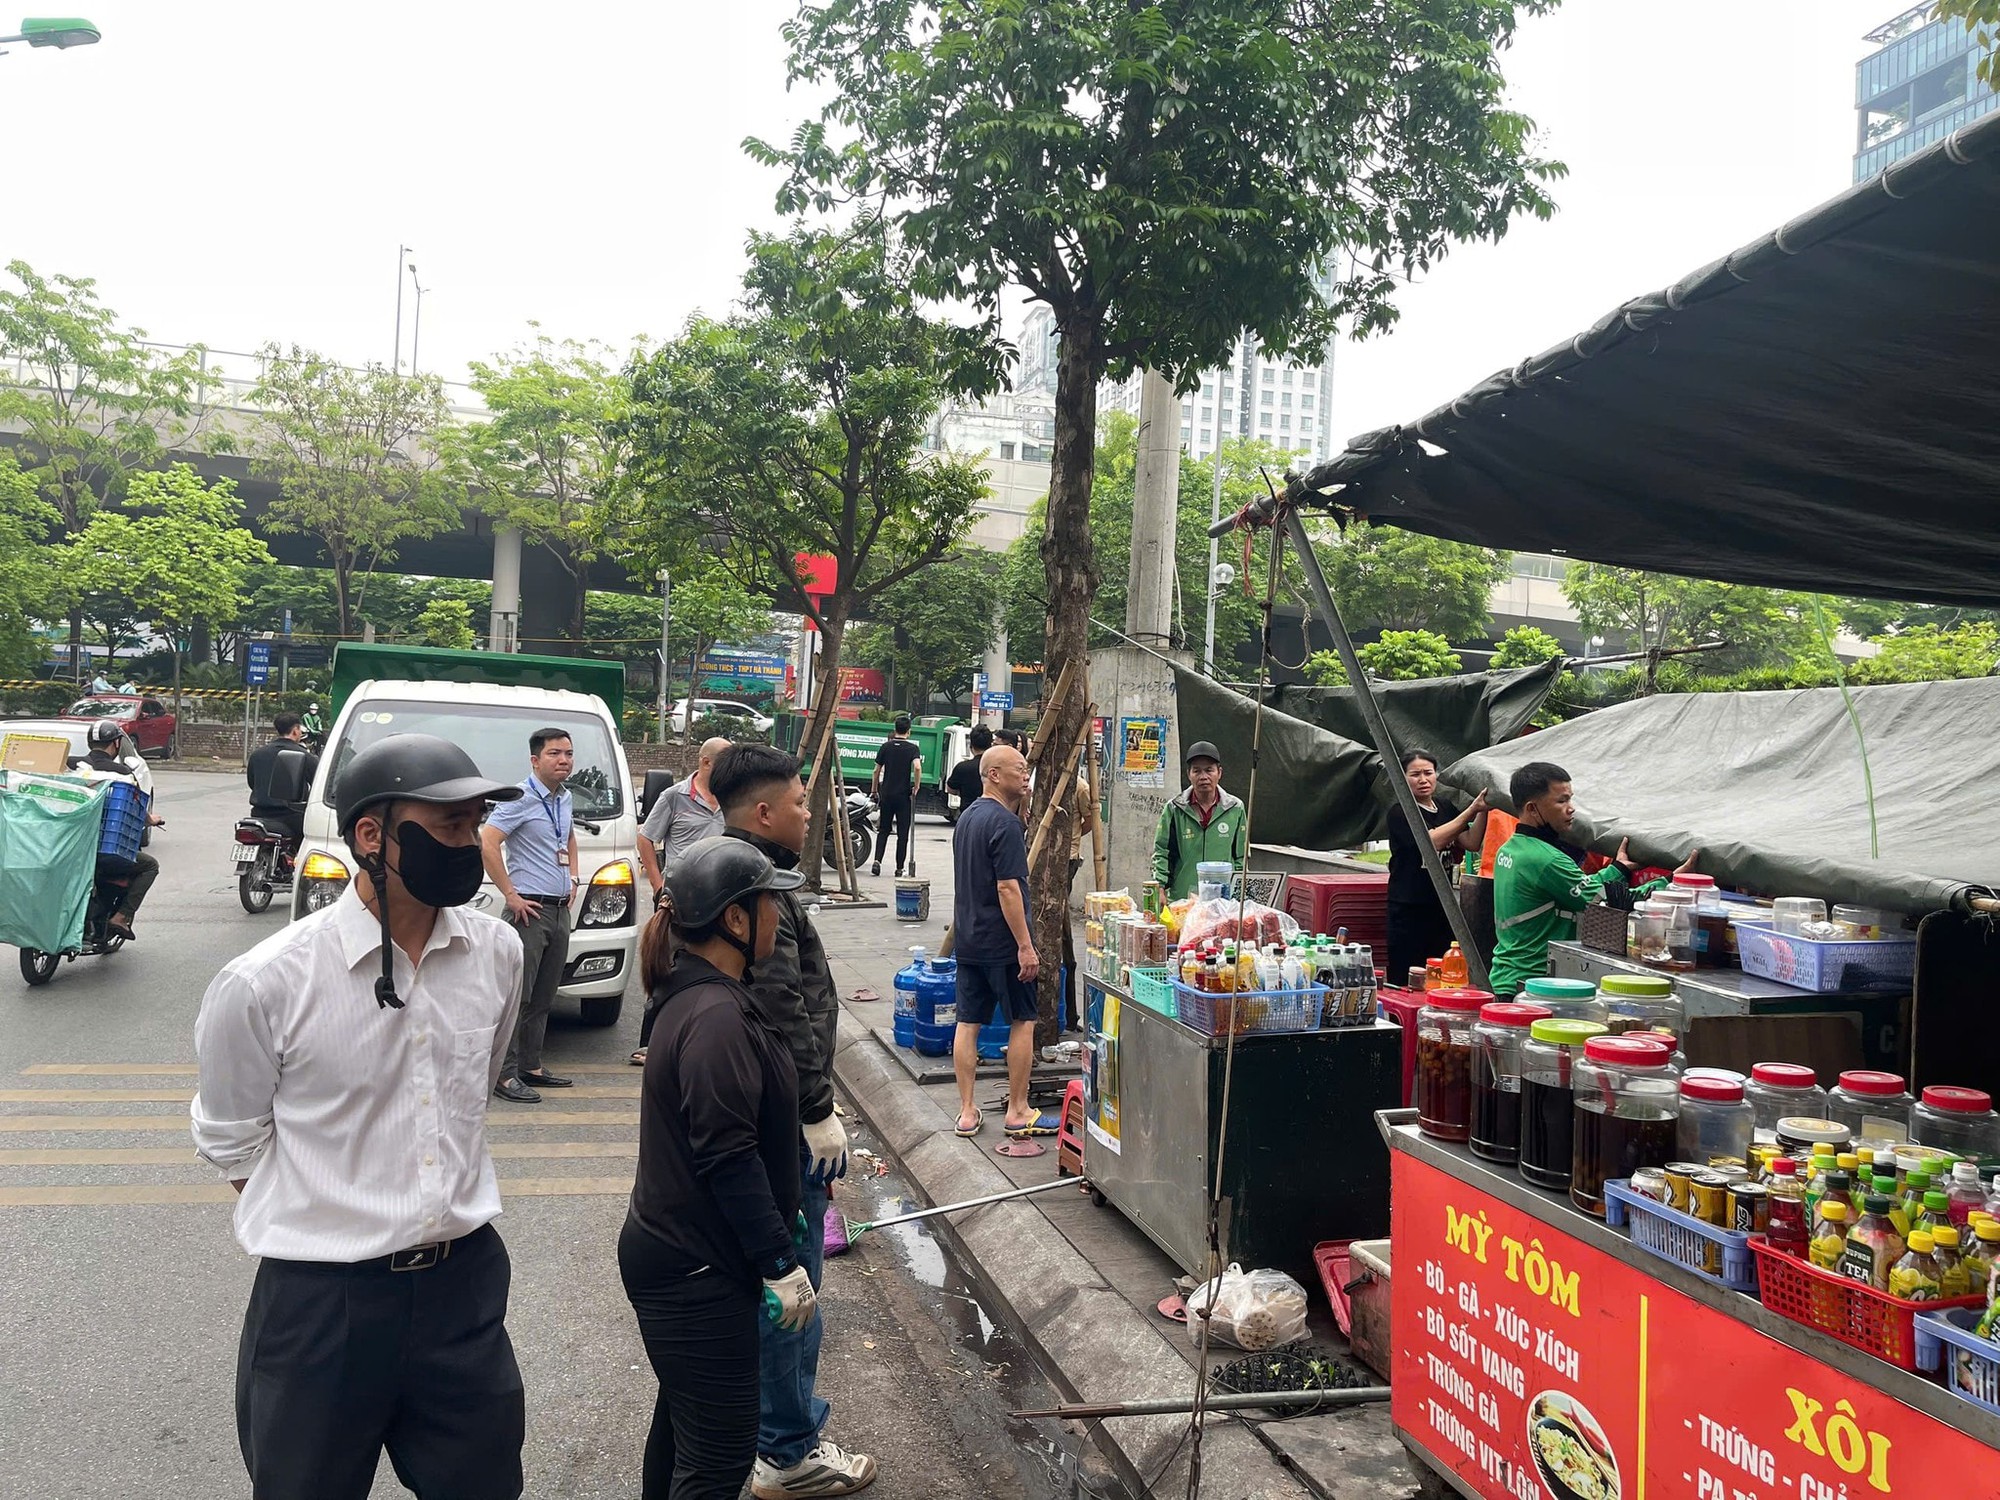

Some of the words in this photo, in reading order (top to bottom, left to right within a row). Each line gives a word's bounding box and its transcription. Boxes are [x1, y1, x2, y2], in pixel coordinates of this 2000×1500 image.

[1497, 852, 1513, 869] Grab
[1445, 1205, 1494, 1264] MỲ
[1501, 1236, 1581, 1317] TÔM
[1846, 1262, 1869, 1281] TEA
[1426, 1259, 1445, 1295] BÒ
[1458, 1281, 1480, 1319] GÀ
[1495, 1303, 1530, 1350] XÚC
[1534, 1327, 1579, 1383] XÍCH
[1426, 1306, 1445, 1342] BÒ
[1449, 1322, 1478, 1365] SỐT
[1481, 1343, 1525, 1400] VANG
[1427, 1351, 1475, 1412] TRỨNG
[1478, 1390, 1500, 1432] GÀ
[1428, 1397, 1476, 1461] TRỨNG
[1698, 1413, 1776, 1487] TRỨNG
[1784, 1387, 1893, 1494] XÔI
[1698, 1467, 1725, 1500] PA
